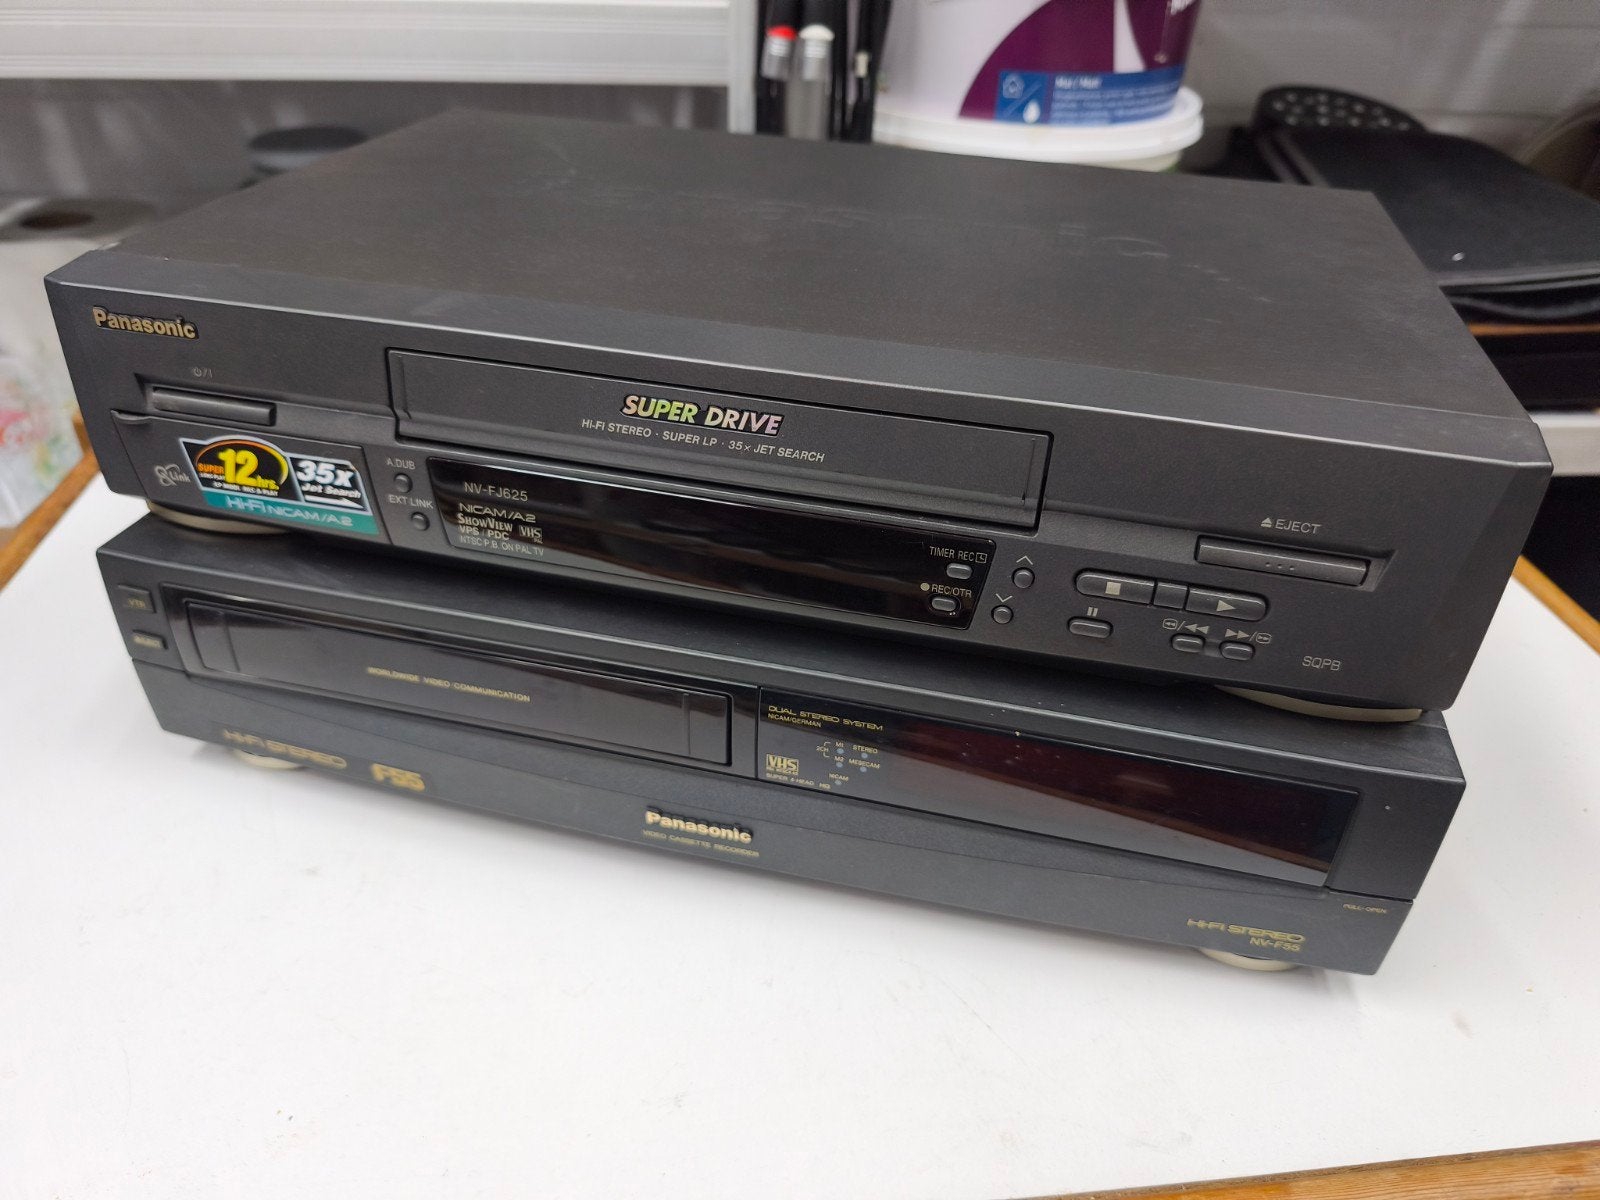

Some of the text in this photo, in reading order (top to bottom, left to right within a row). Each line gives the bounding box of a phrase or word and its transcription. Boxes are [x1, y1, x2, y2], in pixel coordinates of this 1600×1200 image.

[92, 307, 198, 340] Panasonic
[622, 394, 783, 436] SUPER DRIVE
[581, 418, 606, 431] HI-FI
[607, 422, 653, 438] STEREO
[662, 430, 701, 446] SUPER
[702, 436, 718, 447] LP
[753, 443, 777, 455] JET
[777, 447, 825, 463] SEARCH
[197, 462, 224, 475] SUPER
[218, 448, 258, 486] 12
[386, 457, 416, 471] A.DUB
[301, 482, 362, 499] Jet Search
[464, 481, 529, 502] NV-FJ625
[388, 494, 434, 509] EXT LINK
[458, 502, 536, 523] NICAM/A2
[459, 525, 480, 536] VPS
[486, 530, 510, 541] PDC
[519, 524, 543, 539] VHS
[1274, 518, 1322, 534] EJECT
[460, 535, 483, 545] NTSC
[501, 543, 514, 552] ON
[515, 545, 532, 554] PAL
[532, 548, 544, 556] TV
[929, 545, 975, 562] TIMER REC
[931, 583, 972, 599] REC/OTR
[1302, 655, 1342, 671] SQPB
[366, 666, 531, 702] WORLDWIDE VIDEO COMMUNICATION
[767, 713, 822, 728] NICAM/GERMAN
[768, 705, 884, 731] DUAL STEREO SYSTEM
[852, 744, 879, 754] STEREO
[645, 810, 753, 844] Panasonic
[1226, 924, 1306, 943] STEREO
